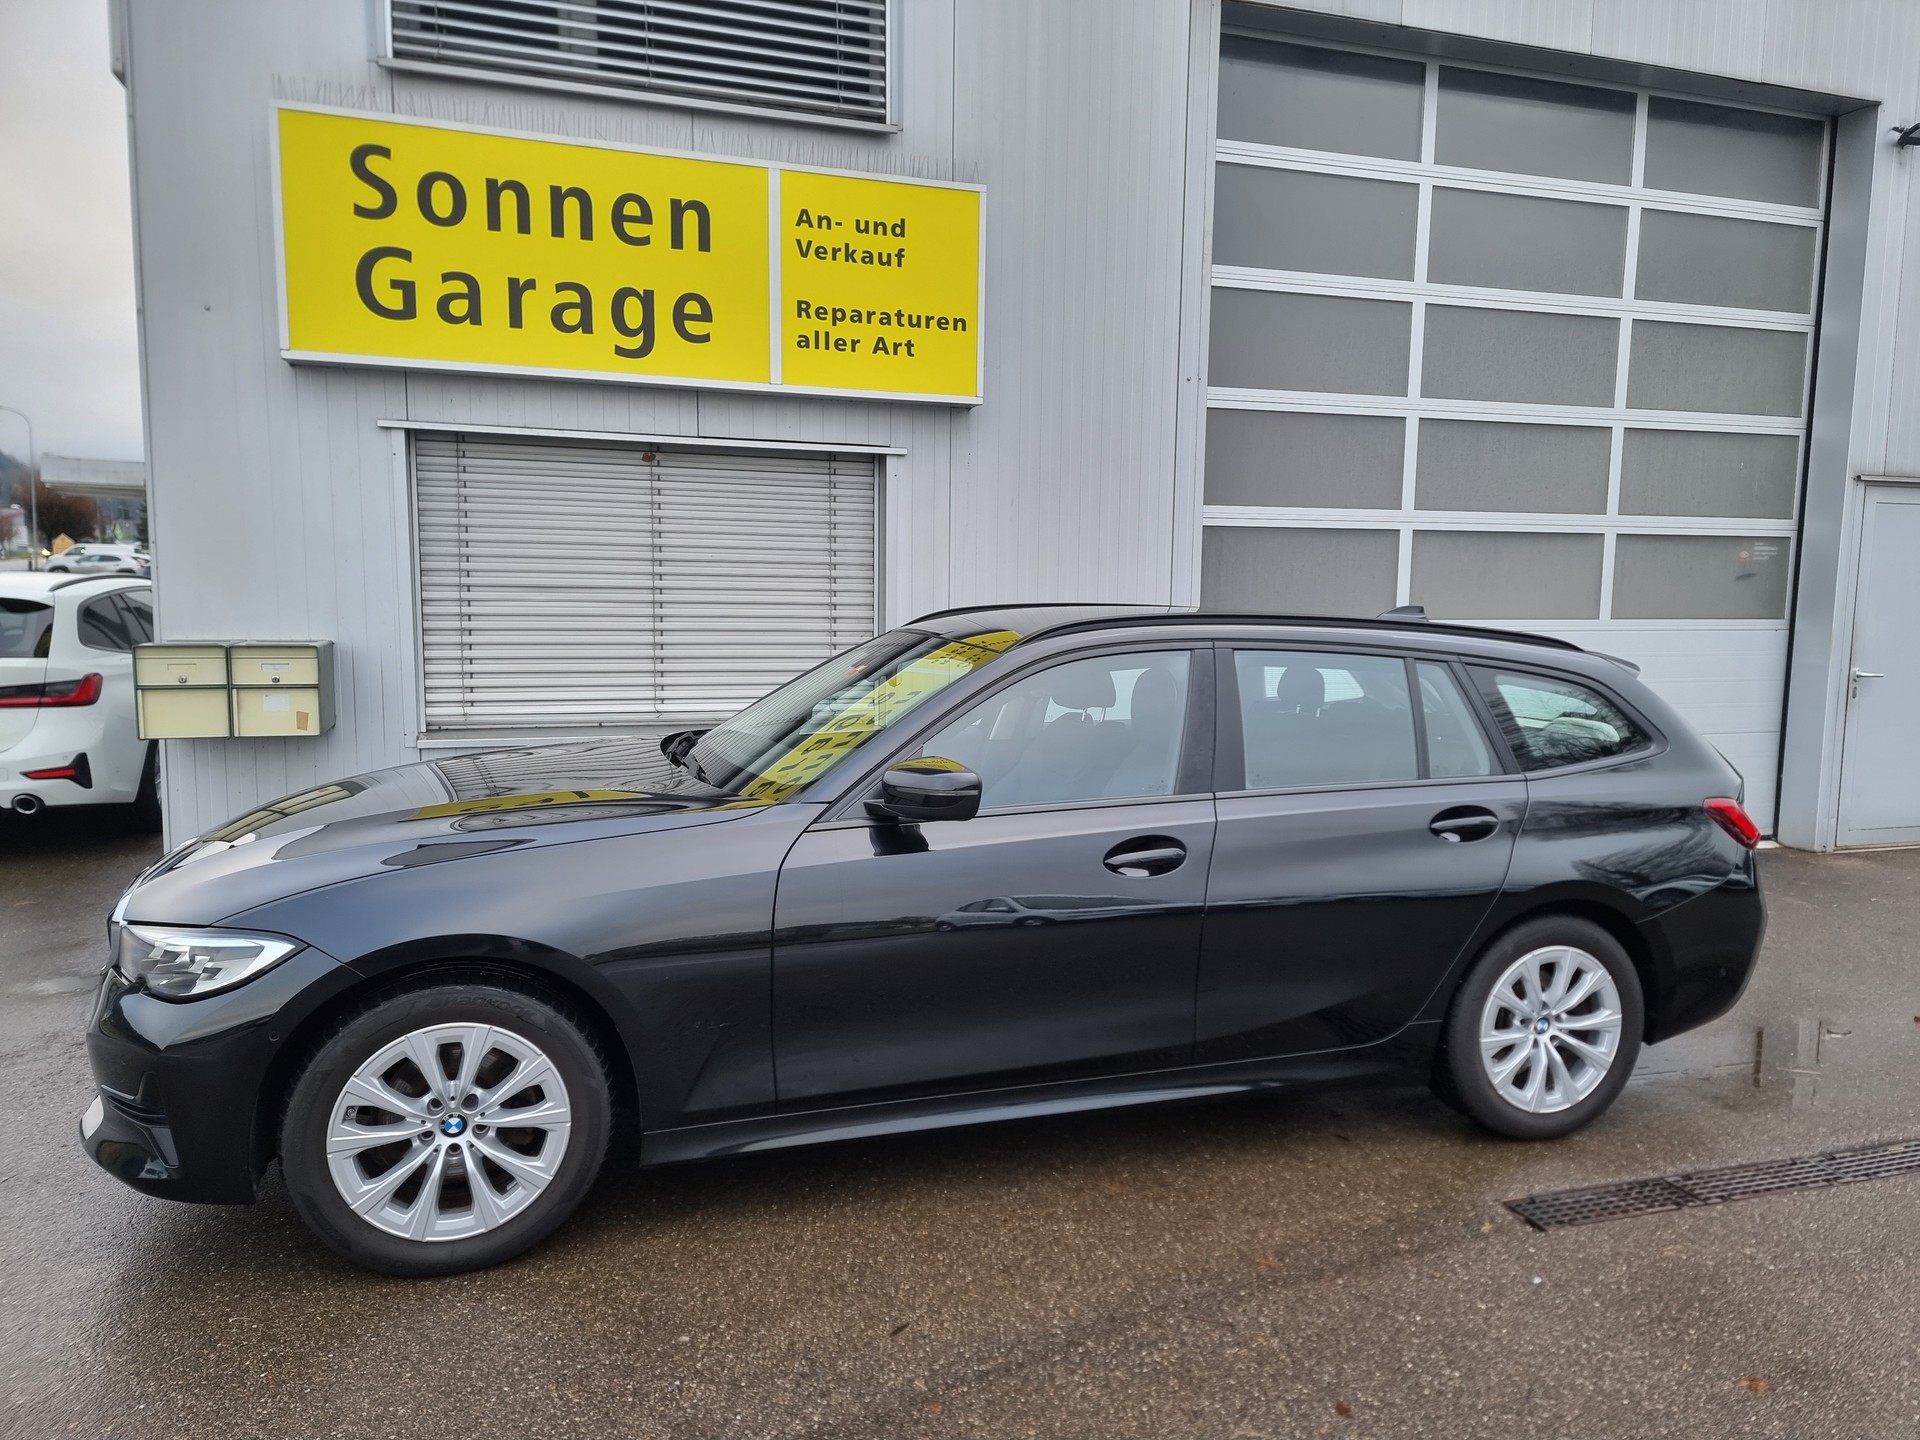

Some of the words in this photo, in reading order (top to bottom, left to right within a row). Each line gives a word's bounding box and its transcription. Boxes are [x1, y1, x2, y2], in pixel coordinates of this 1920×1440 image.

[349, 143, 711, 253] Sonnen
[795, 208, 843, 232] An-
[855, 218, 906, 238] und
[795, 238, 906, 268] Verkauf
[355, 246, 713, 358] Garage
[796, 300, 967, 332] Reparaturen
[796, 330, 861, 353] aller
[871, 337, 916, 356] Art
